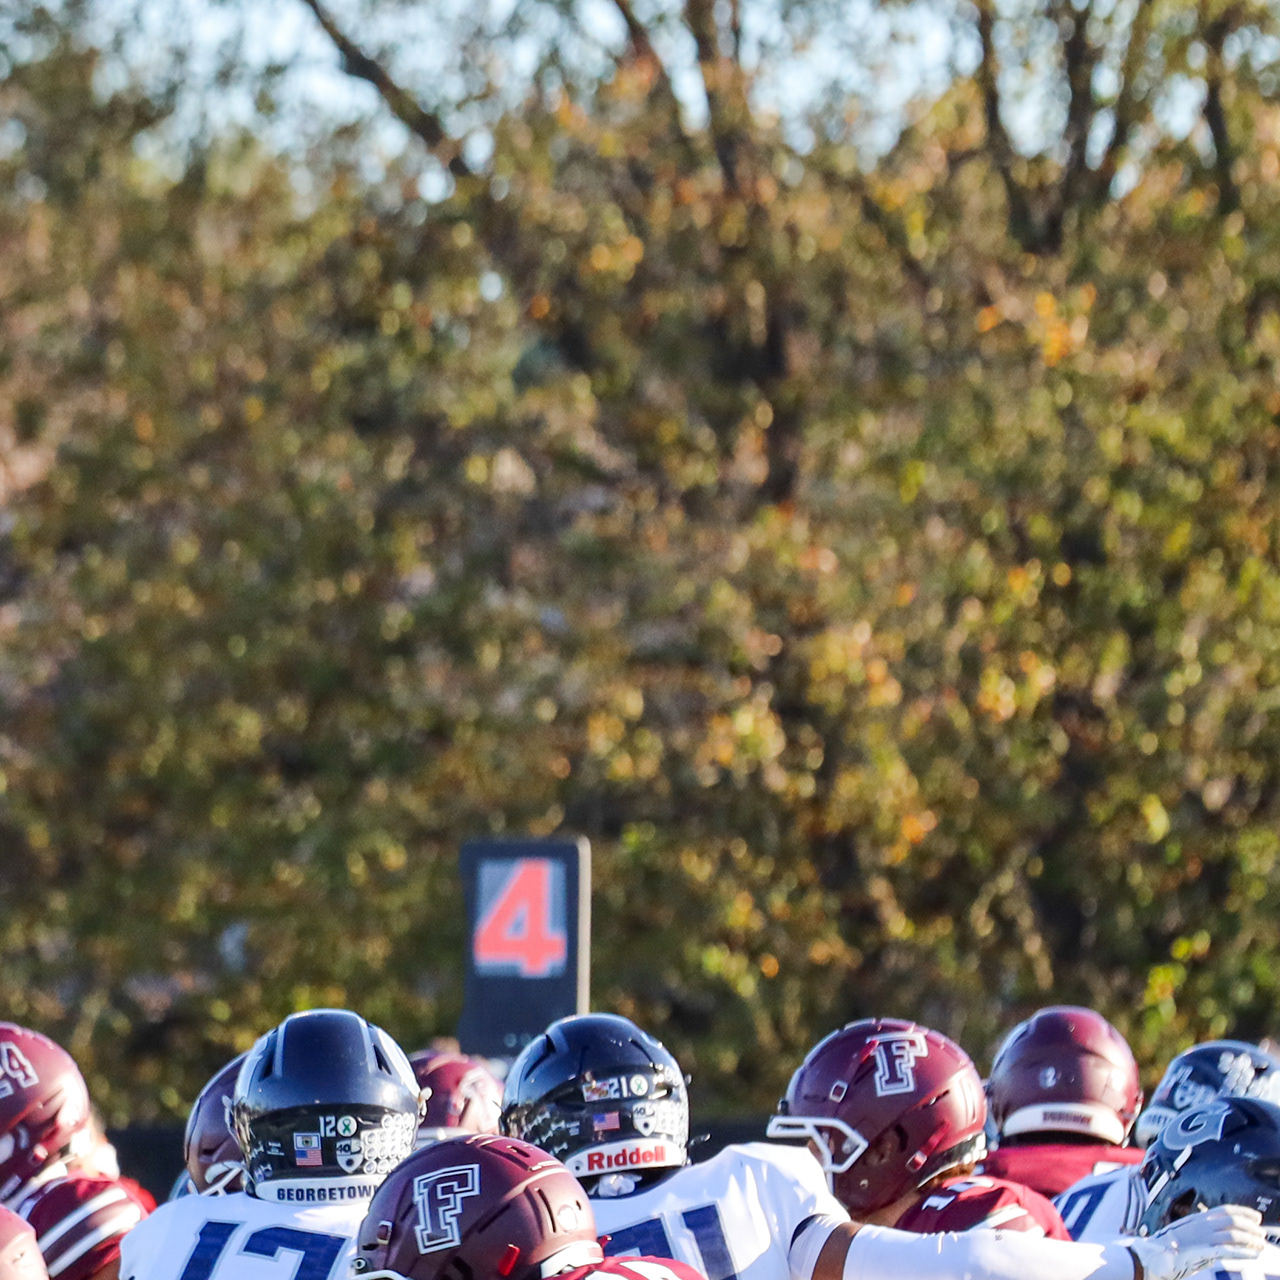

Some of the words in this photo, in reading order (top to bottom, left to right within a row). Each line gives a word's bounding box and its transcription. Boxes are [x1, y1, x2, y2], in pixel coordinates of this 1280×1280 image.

[474, 858, 567, 977] 4
[866, 1032, 929, 1097] F
[319, 1115, 337, 1137] 12
[587, 1145, 667, 1171] Riddell
[412, 1163, 481, 1255] F
